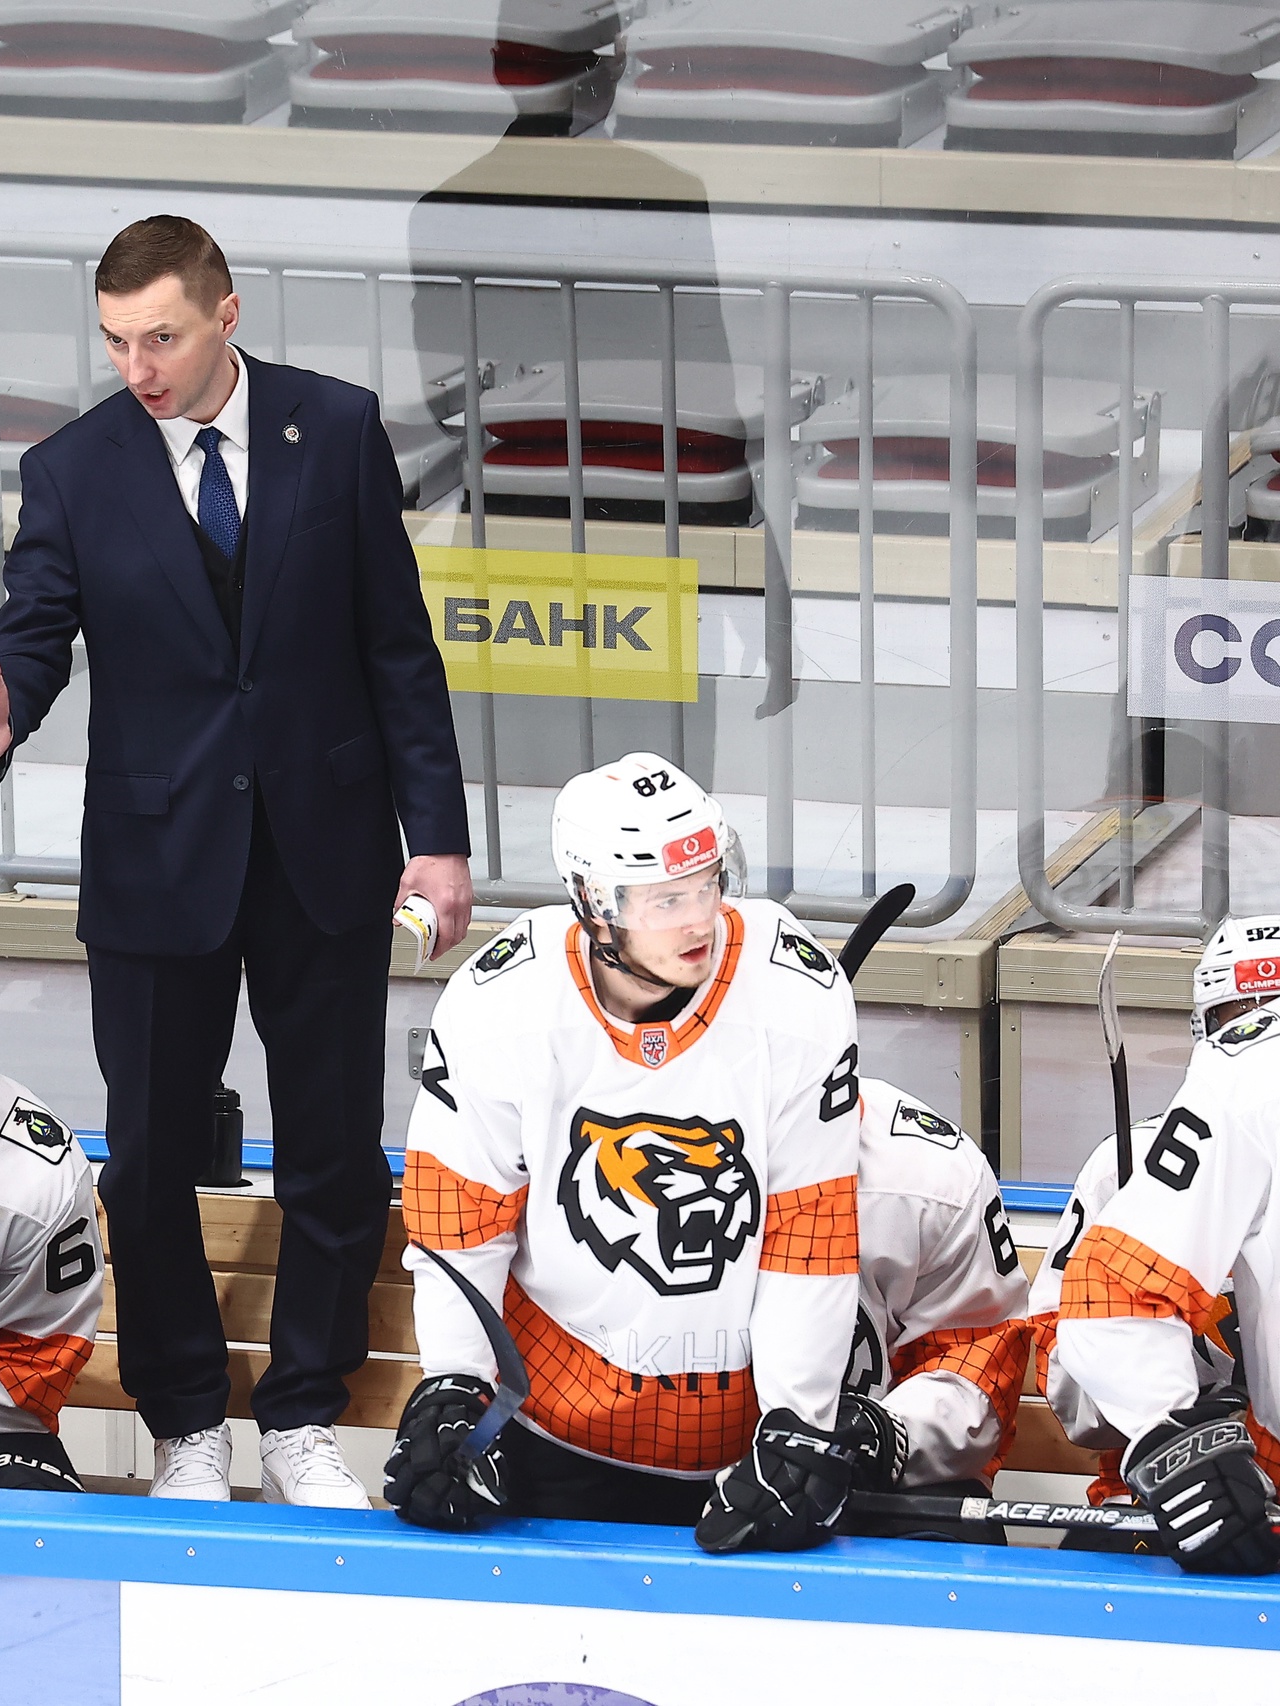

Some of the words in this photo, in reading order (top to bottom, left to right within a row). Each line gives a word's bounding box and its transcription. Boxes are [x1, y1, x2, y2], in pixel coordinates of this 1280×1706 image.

[444, 596, 653, 652] БАНК
[632, 769, 677, 798] 82
[565, 849, 592, 868] CCM
[668, 848, 718, 874] OLIMPBET
[819, 1042, 859, 1123] 8
[1144, 1106, 1212, 1192] 6
[44, 1215, 97, 1296] 6
[986, 1502, 1051, 1521] ACE
[1047, 1506, 1121, 1524] prime
